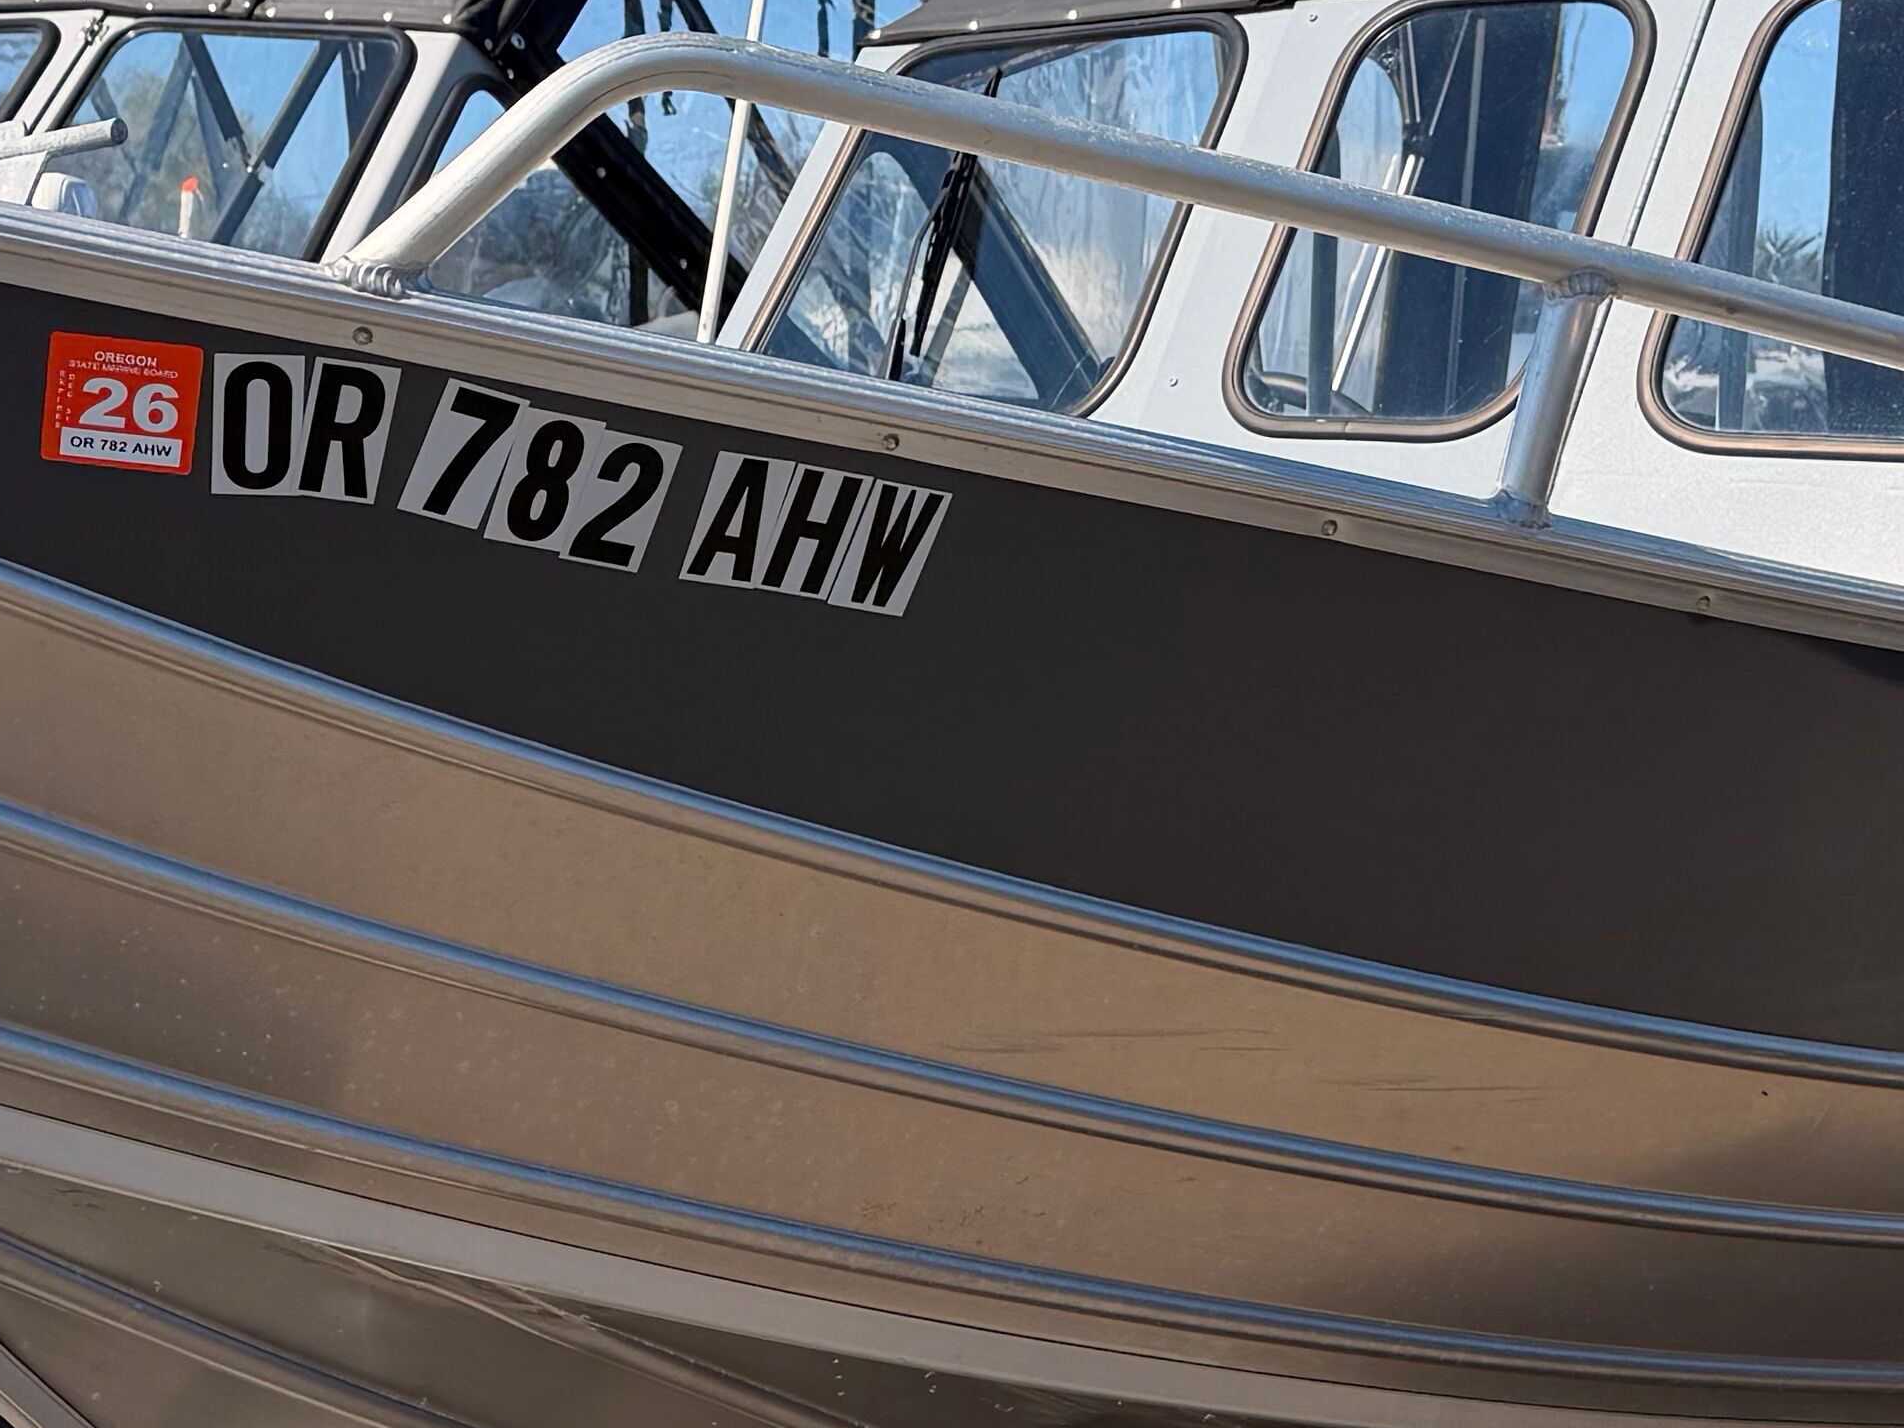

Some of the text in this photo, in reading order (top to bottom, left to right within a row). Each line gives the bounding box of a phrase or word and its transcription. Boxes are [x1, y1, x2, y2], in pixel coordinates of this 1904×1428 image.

[69, 359, 100, 371] STATE
[143, 369, 179, 379] BOARD
[94, 351, 158, 367] OREGON
[79, 377, 179, 433] 26
[70, 436, 172, 457] OR 782 AHW
[222, 360, 945, 608] OR 782 AHW
